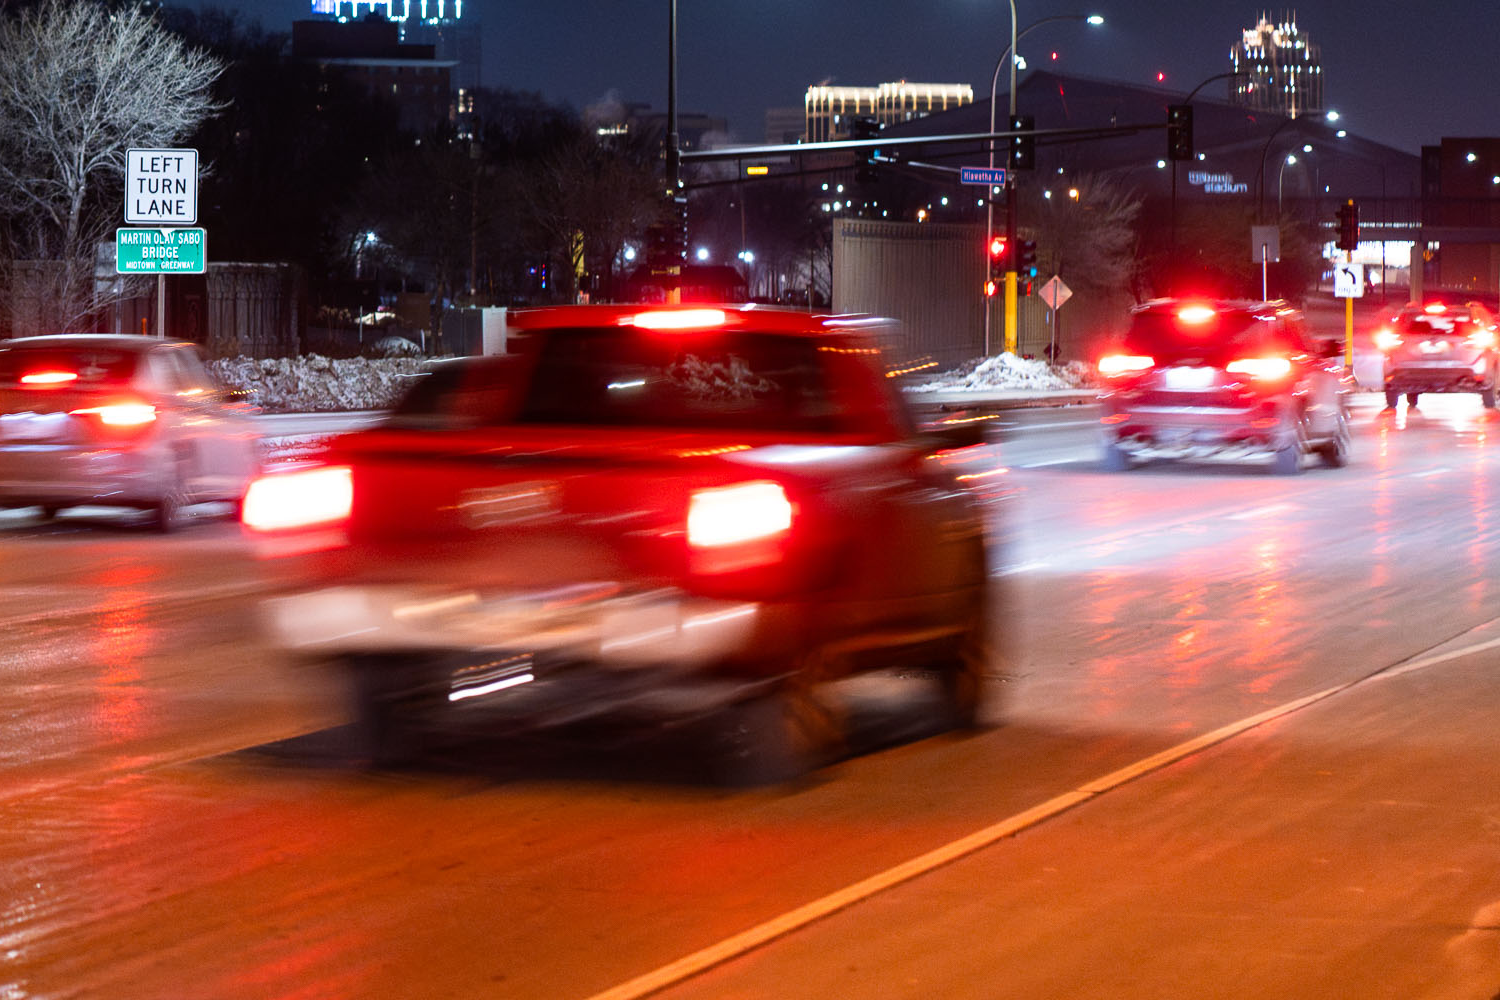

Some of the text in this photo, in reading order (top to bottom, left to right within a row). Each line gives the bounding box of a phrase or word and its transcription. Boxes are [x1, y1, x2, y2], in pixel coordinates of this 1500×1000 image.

[140, 157, 184, 173] LEFT
[136, 177, 186, 194] TURN
[136, 199, 185, 215] LANE
[120, 232, 200, 244] MARTIN OLAV SABO
[142, 246, 179, 258] BRIDGE
[126, 261, 195, 269] MIDTOWN GREENWAY
